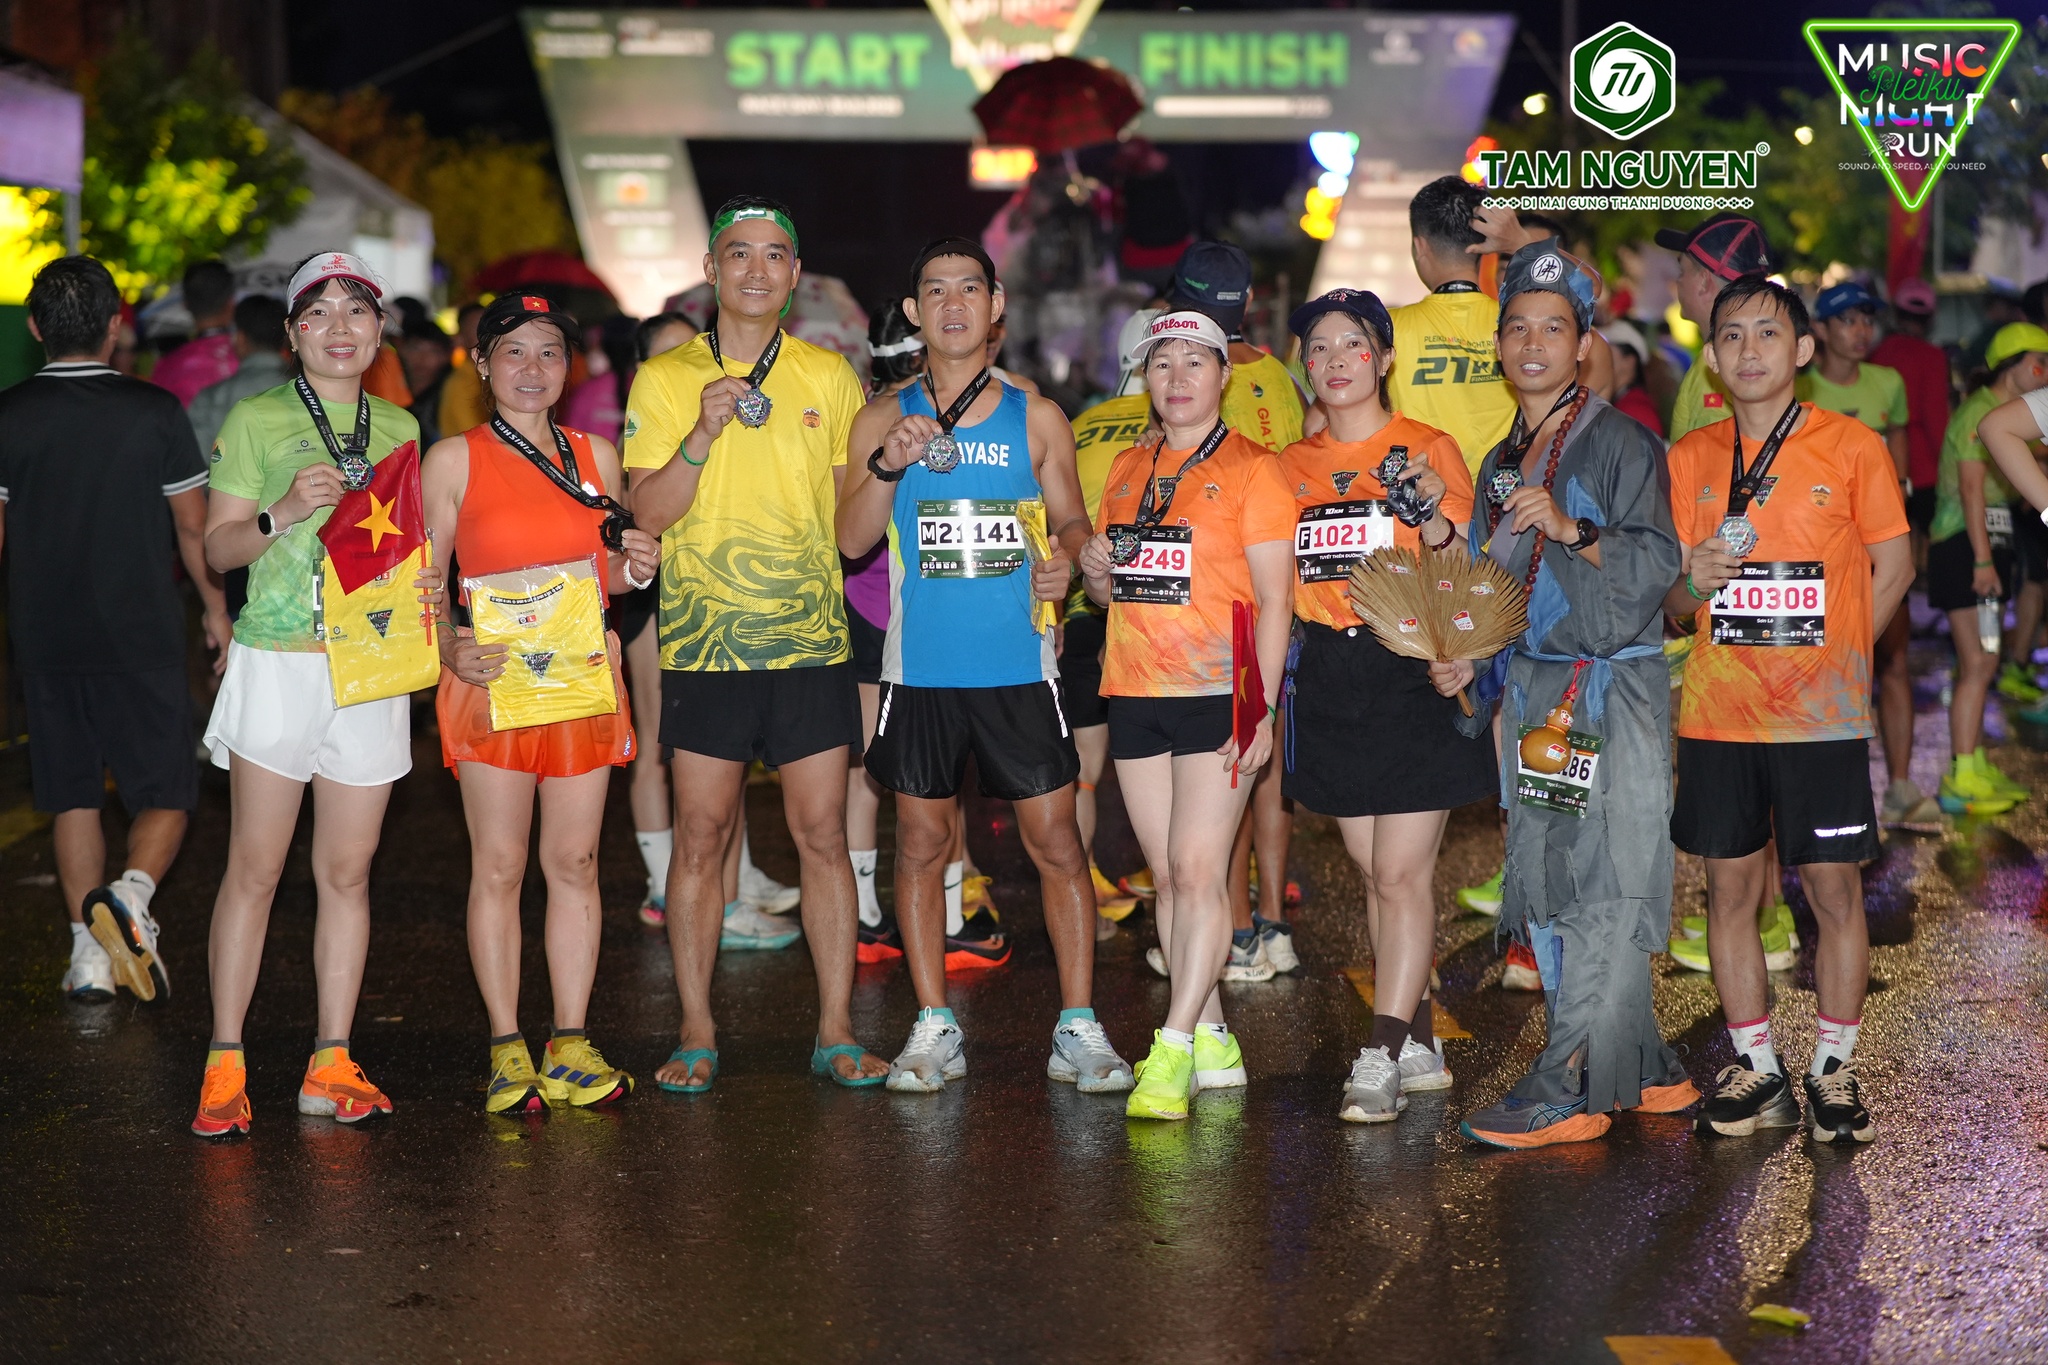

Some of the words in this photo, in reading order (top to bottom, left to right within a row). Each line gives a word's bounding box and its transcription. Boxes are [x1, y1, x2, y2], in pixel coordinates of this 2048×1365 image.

[725, 32, 930, 88] START
[1140, 32, 1349, 88] FINISH
[1151, 318, 1200, 335] Wilson
[1257, 407, 1271, 437] GIA
[922, 524, 936, 541] M
[1300, 530, 1310, 547] F
[1313, 523, 1370, 548] 1021
[1743, 567, 1769, 575] 10KM
[1714, 588, 1728, 606] M
[1732, 586, 1818, 610] 10308
